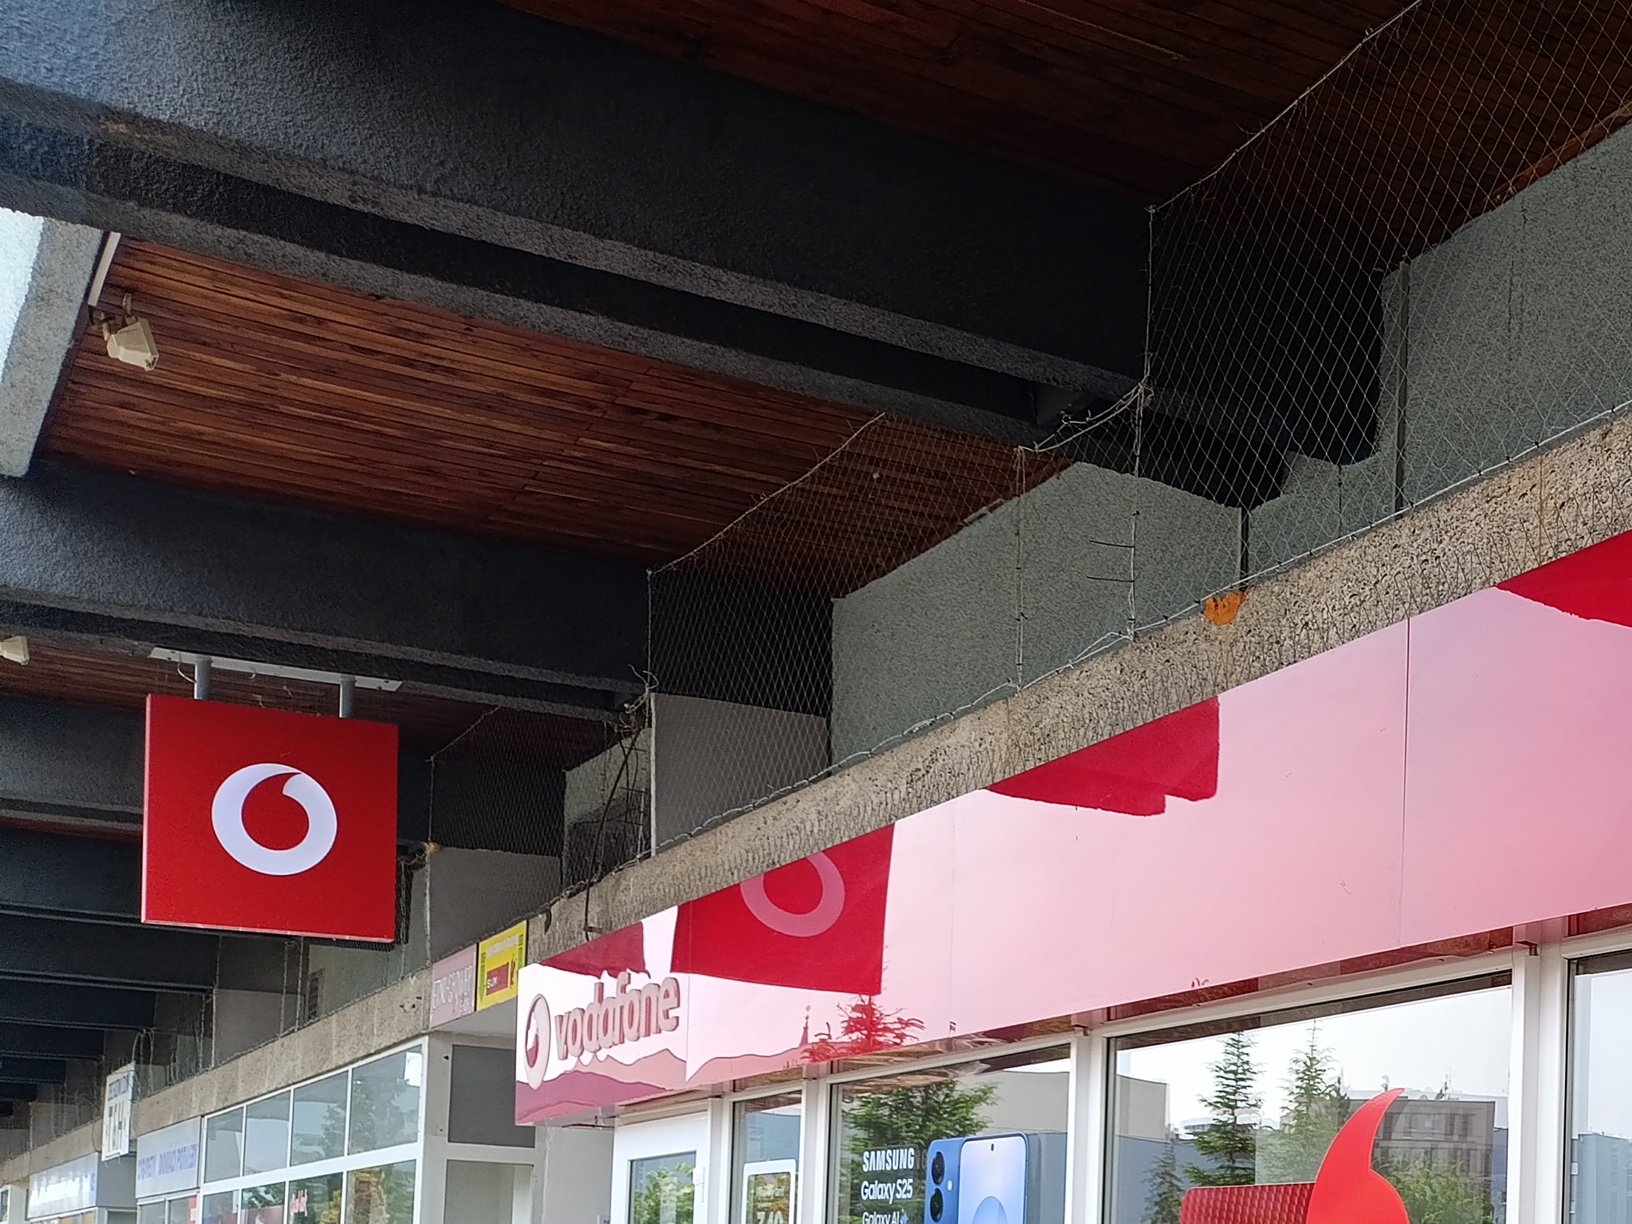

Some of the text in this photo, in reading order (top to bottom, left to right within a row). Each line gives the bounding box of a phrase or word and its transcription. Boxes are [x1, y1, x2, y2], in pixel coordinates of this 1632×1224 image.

[554, 971, 681, 1060] vodafone
[862, 1148, 915, 1172] SAMSUNG
[861, 1179, 913, 1205] Galaxy S25
